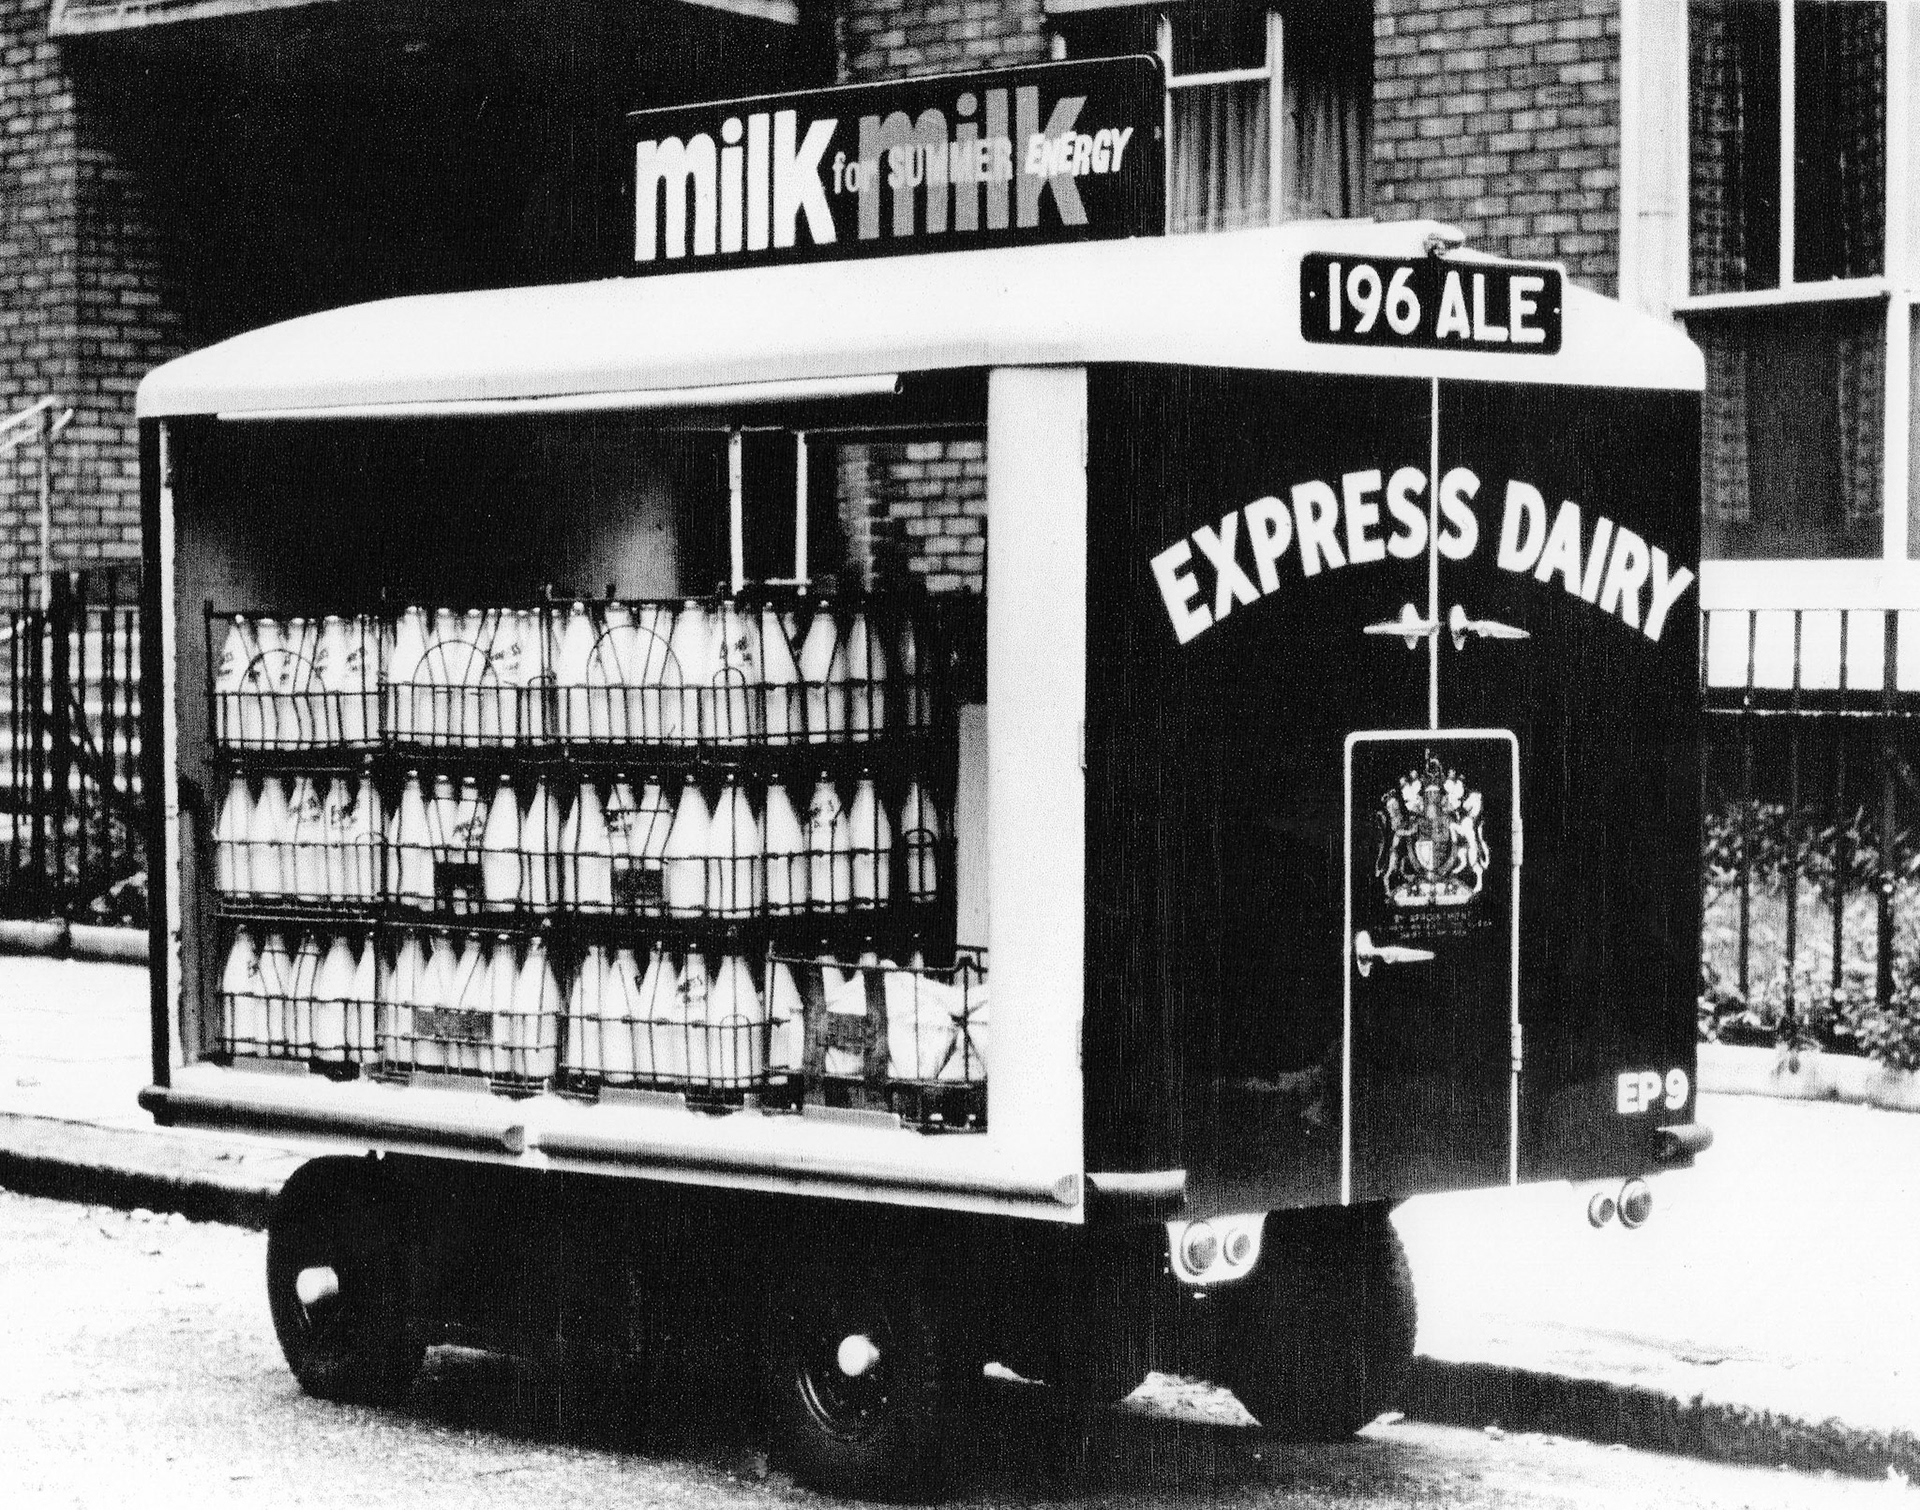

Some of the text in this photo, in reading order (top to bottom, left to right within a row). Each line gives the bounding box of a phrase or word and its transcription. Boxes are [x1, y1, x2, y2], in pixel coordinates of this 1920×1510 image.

[635, 110, 1134, 261] milk for SUMMER ENERGY
[858, 86, 1089, 240] milk
[1328, 262, 1546, 343] 196 ALE
[1150, 466, 1694, 645] EXPRESS DAIRY
